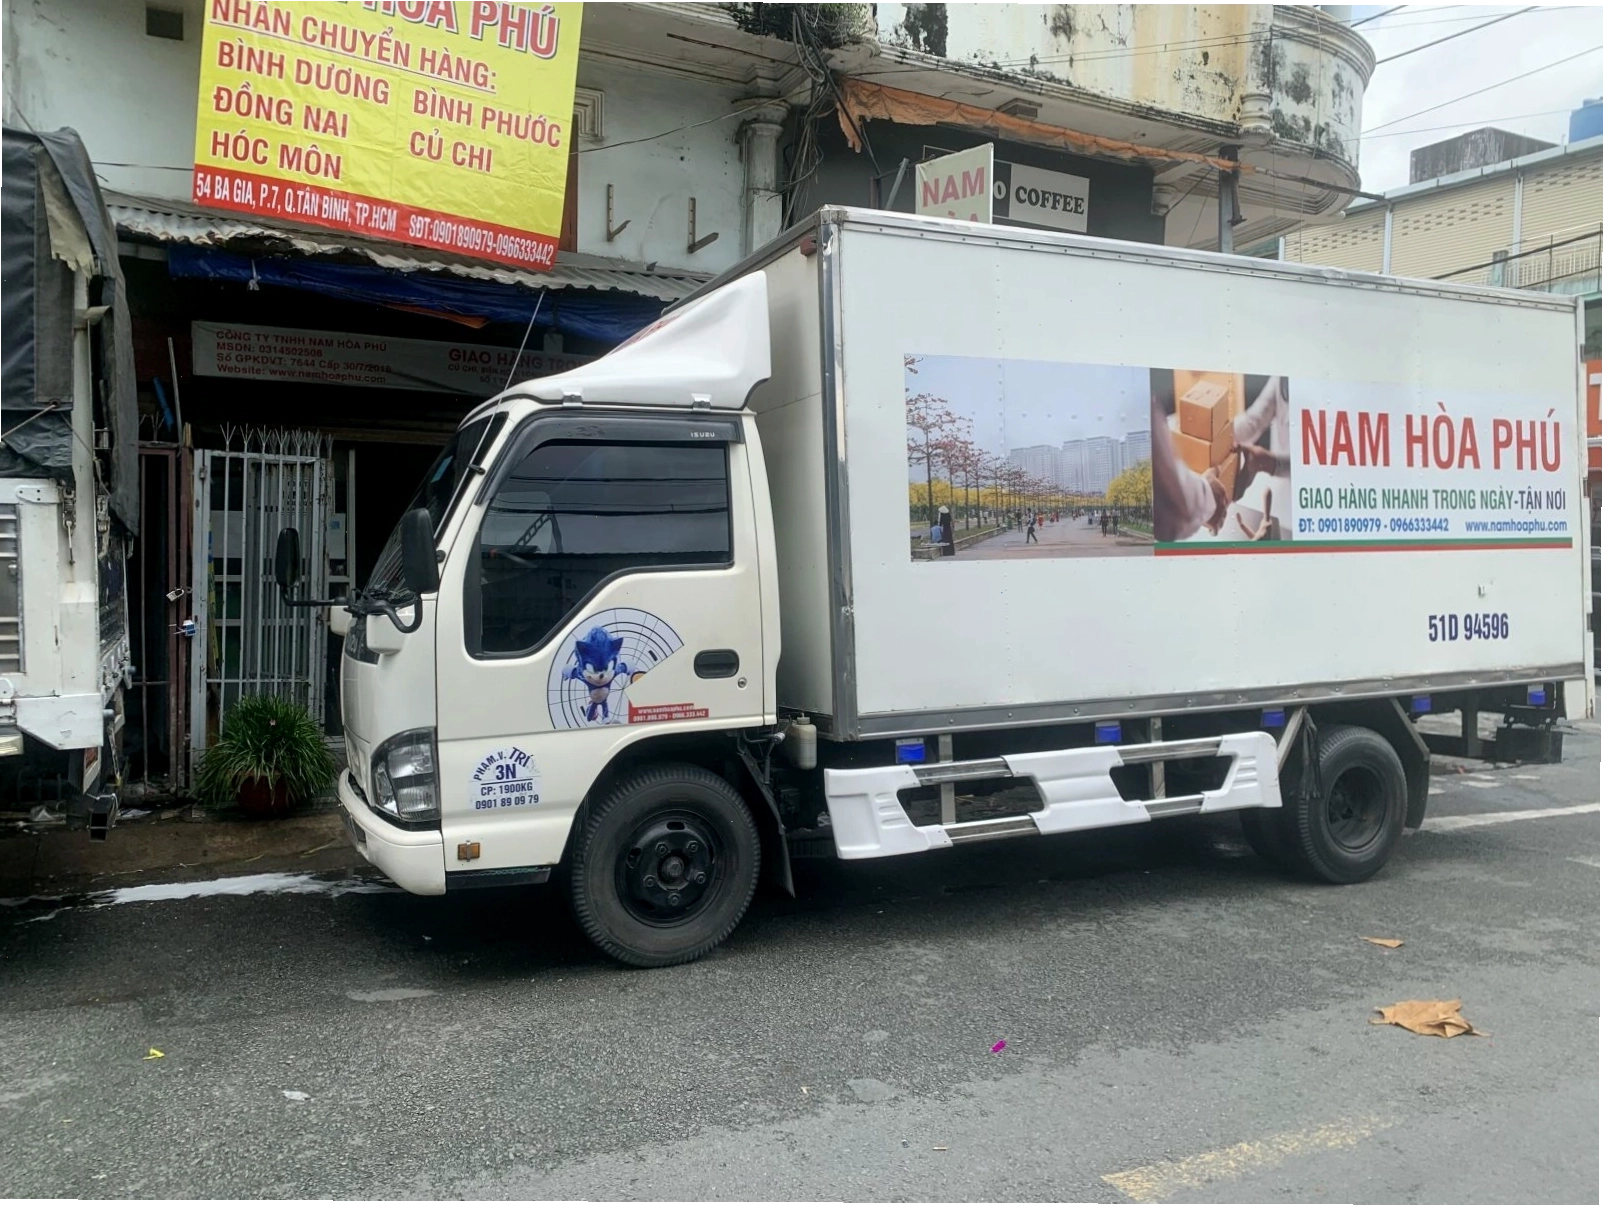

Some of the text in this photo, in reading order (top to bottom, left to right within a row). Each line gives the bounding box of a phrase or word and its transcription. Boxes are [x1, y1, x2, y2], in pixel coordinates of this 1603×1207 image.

[470, 0, 558, 57] PHÚ
[301, 15, 410, 67] CHUYỂN
[419, 45, 497, 90] HÀNG:
[218, 37, 390, 105] BÌNH DƯƠNG
[213, 81, 349, 138] ĐỒNG NAI
[412, 87, 561, 148] BÌNH PHƯỚC
[211, 129, 342, 180] HÓC MÔN
[410, 128, 492, 172] CỦ CHI
[922, 166, 985, 208] NAM
[1015, 185, 1085, 215] COFFEE
[196, 173, 397, 232] 54 BA GIA, P.7, Q.TÂN BÌNH, TP.HCM
[216, 329, 387, 351] CÔNG TY TNHH NAM HÒA PHÚ
[216, 342, 255, 353] MSDN:
[216, 352, 232, 362] Số
[319, 359, 340, 371] Cấp
[448, 348, 492, 364] GIAO
[497, 350, 543, 369] HÀNG
[217, 363, 386, 383] Website: www.namhoaphu.com
[1301, 402, 1561, 472] NAM HÒA PHÚ
[1299, 487, 1334, 509] GIAO
[1339, 483, 1377, 509] HÀNG
[1381, 489, 1429, 510] NHANH
[1433, 489, 1476, 510] TRONG
[1298, 518, 1315, 533] ĐT:
[1318, 518, 1381, 533] 0901890979
[1389, 518, 1449, 533] 0966333442
[1465, 518, 1567, 534] www.namhoaphu.com
[1428, 613, 1509, 641] 51D 94596
[496, 763, 517, 780] 3N
[475, 794, 539, 810] 0901 89 09 79
[480, 782, 533, 796] CP: 1900KG
